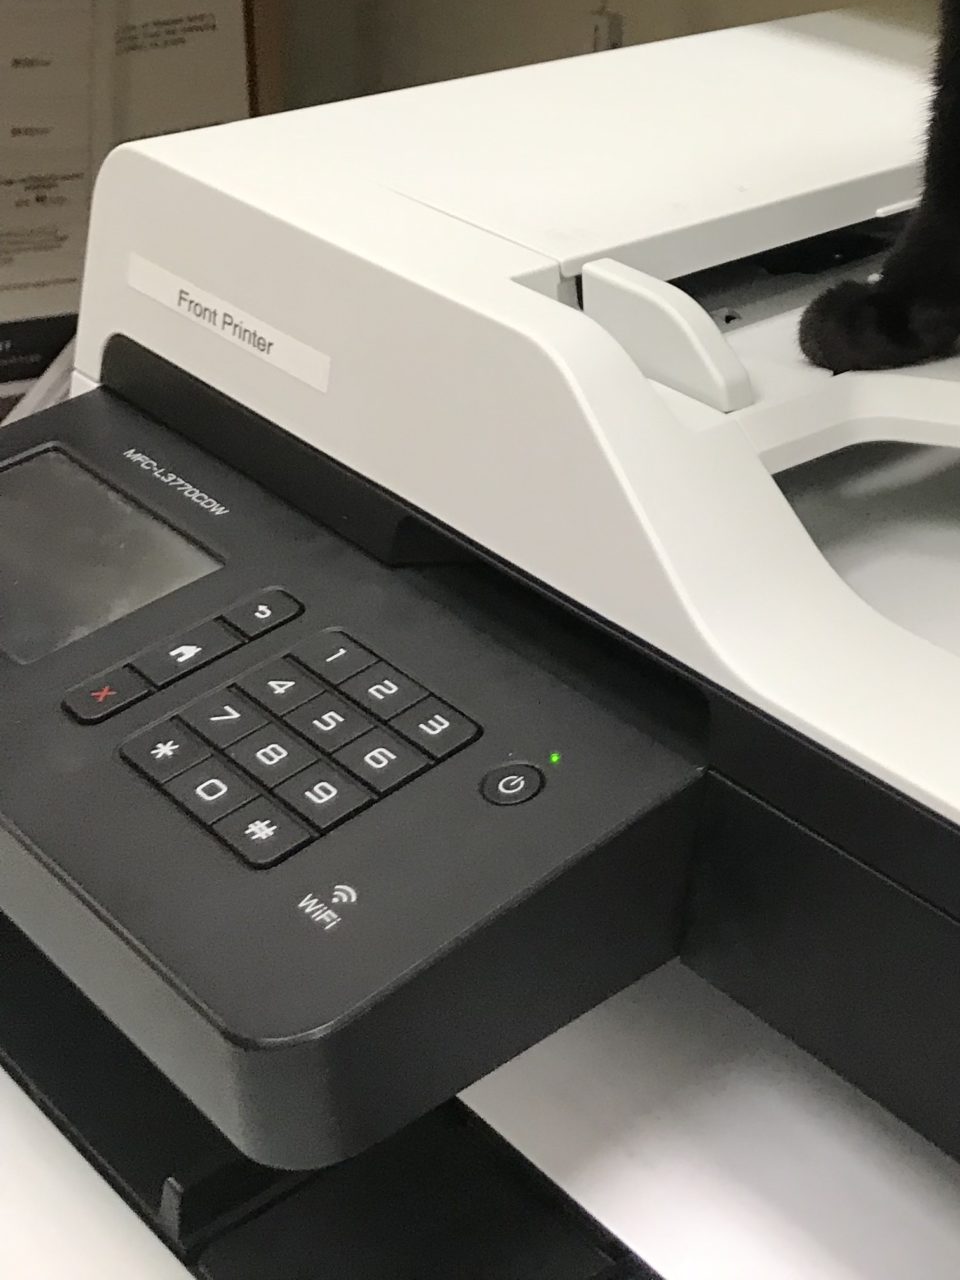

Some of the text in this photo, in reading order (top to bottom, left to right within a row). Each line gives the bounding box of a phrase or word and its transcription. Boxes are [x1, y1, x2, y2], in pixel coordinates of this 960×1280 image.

[176, 289, 274, 355] Front Printer
[123, 448, 230, 516] MFC-L3770CDW
[267, 678, 397, 769] 4 5 6
[324, 648, 450, 736] 1 2 3
[209, 705, 338, 805] 7 8 9
[244, 818, 278, 841] #
[298, 893, 342, 930] WiFi
